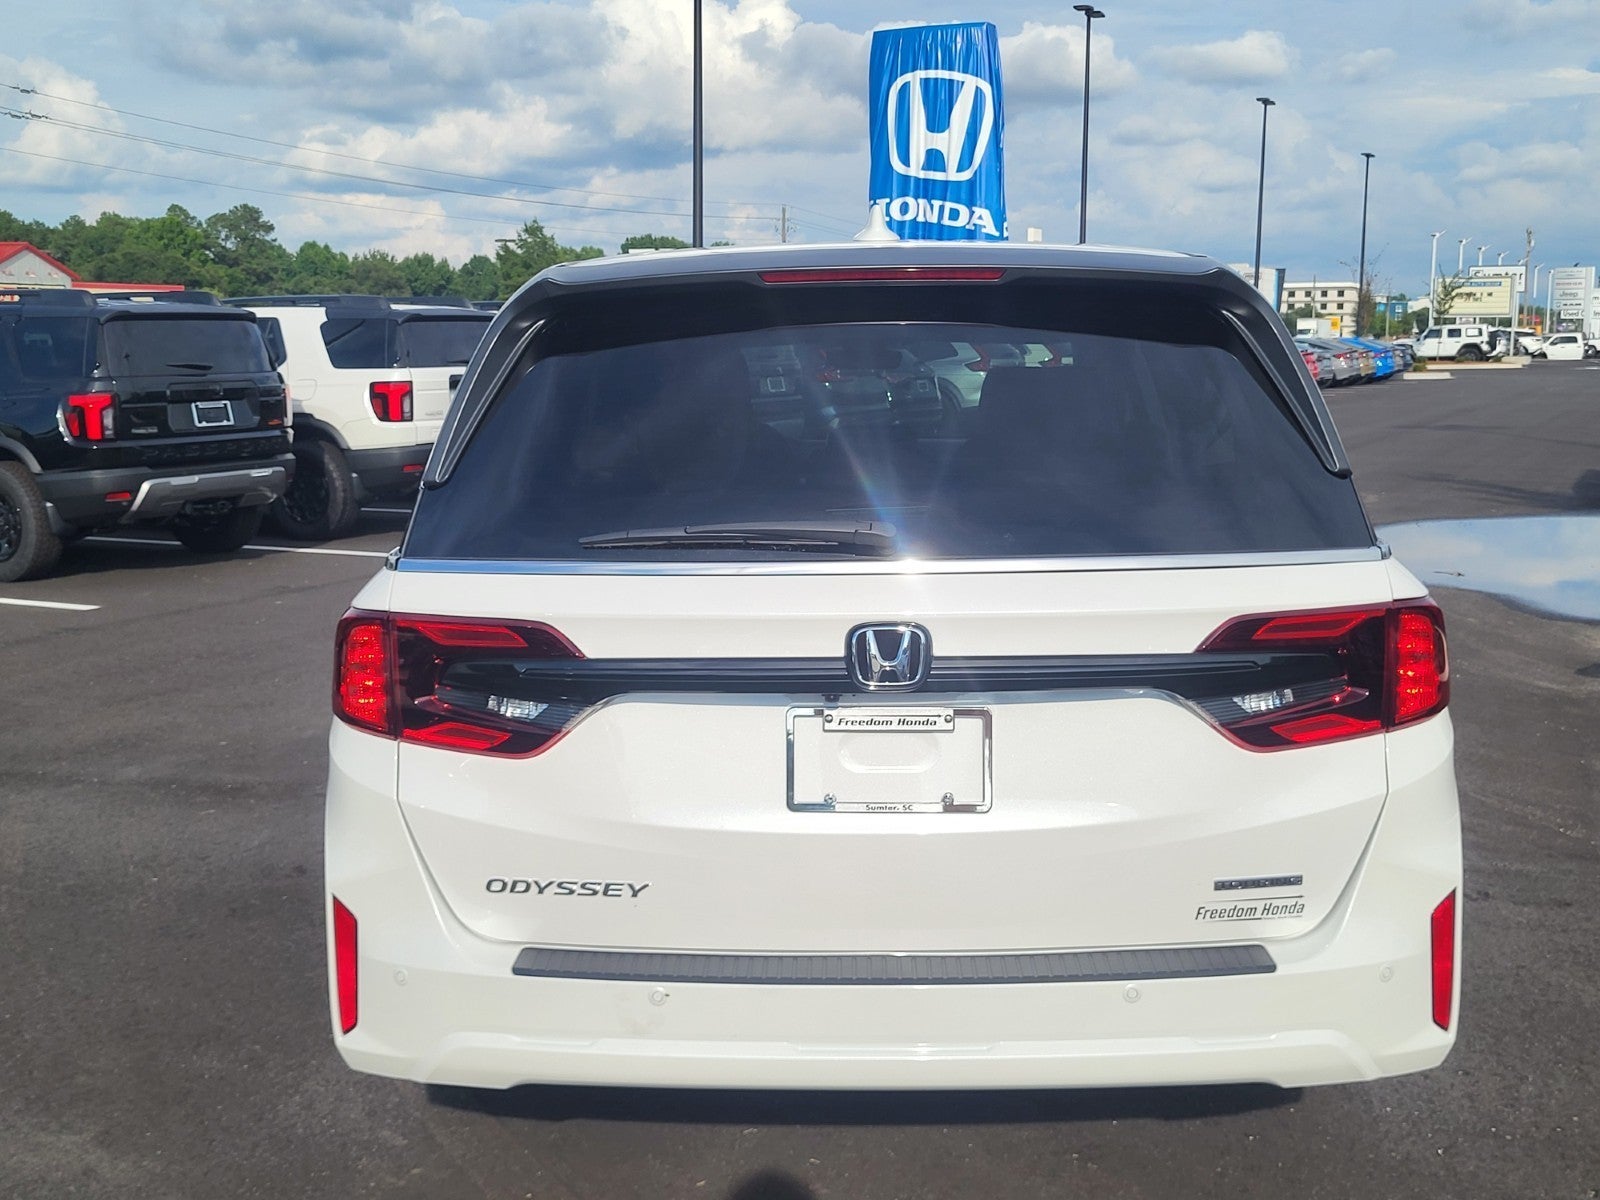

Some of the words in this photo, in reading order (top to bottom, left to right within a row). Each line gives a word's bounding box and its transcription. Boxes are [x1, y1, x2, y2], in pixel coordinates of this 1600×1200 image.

[837, 717, 894, 727] Freedom
[897, 717, 938, 727] Honda
[485, 878, 650, 898] ODYSSEY
[1195, 904, 1258, 921] Freedom
[1261, 900, 1306, 917] Honda
